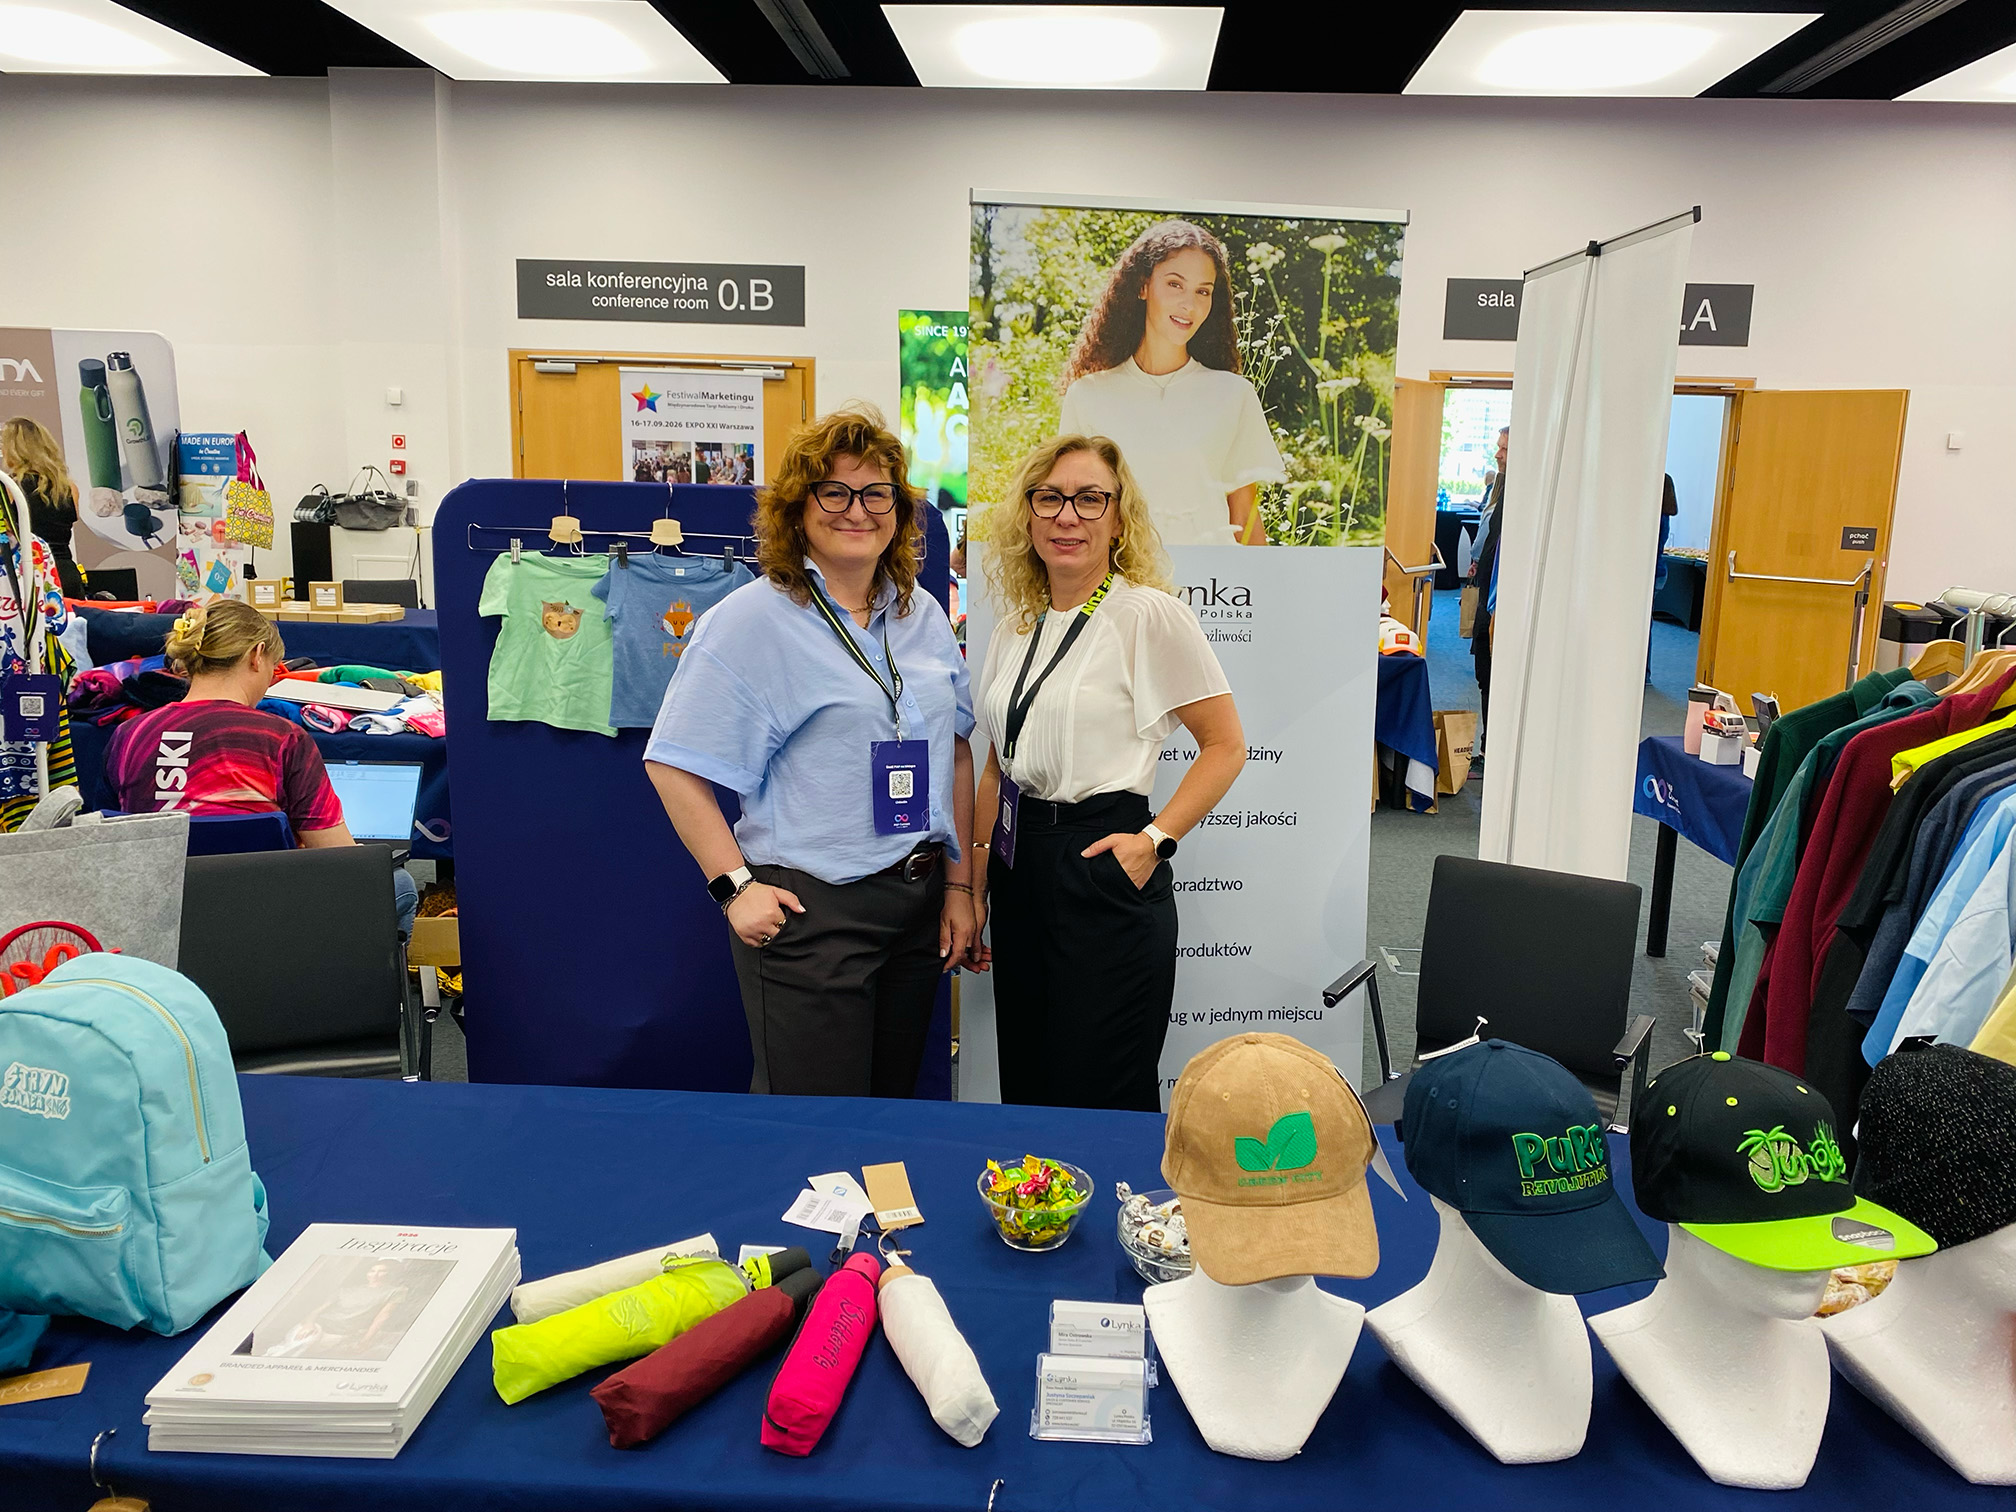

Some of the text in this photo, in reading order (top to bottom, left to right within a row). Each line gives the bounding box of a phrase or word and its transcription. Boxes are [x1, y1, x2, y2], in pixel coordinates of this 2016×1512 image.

[546, 271, 774, 312] sala konferencyjna 0.B
[1477, 289, 1516, 308] sala
[591, 294, 709, 310] conference room
[914, 325, 969, 337] SINCE 19
[666, 390, 754, 403] FestiwalMarketingu
[630, 419, 683, 429] 16-17.09.2026
[685, 421, 705, 429] EXPO
[181, 437, 236, 446] MADE IN EUROP
[1178, 577, 1253, 607] nka
[1200, 609, 1253, 618] Polska
[662, 642, 687, 658] FO
[1183, 750, 1197, 760] w
[1246, 746, 1283, 764] dziny
[154, 731, 194, 813] NSKI
[1200, 810, 1297, 828] yższej jakości
[1172, 877, 1243, 892] oradztwo
[1169, 1006, 1323, 1025] ug w jednym miejscu
[338, 1237, 459, 1257] Inspiracje
[812, 1296, 867, 1370] Butterfly
[1111, 1320, 1141, 1331] Lynka
[219, 1362, 264, 1370] BRANDED
[314, 1366, 381, 1374] MERCHANDISE
[349, 1383, 389, 1393] Lynka
